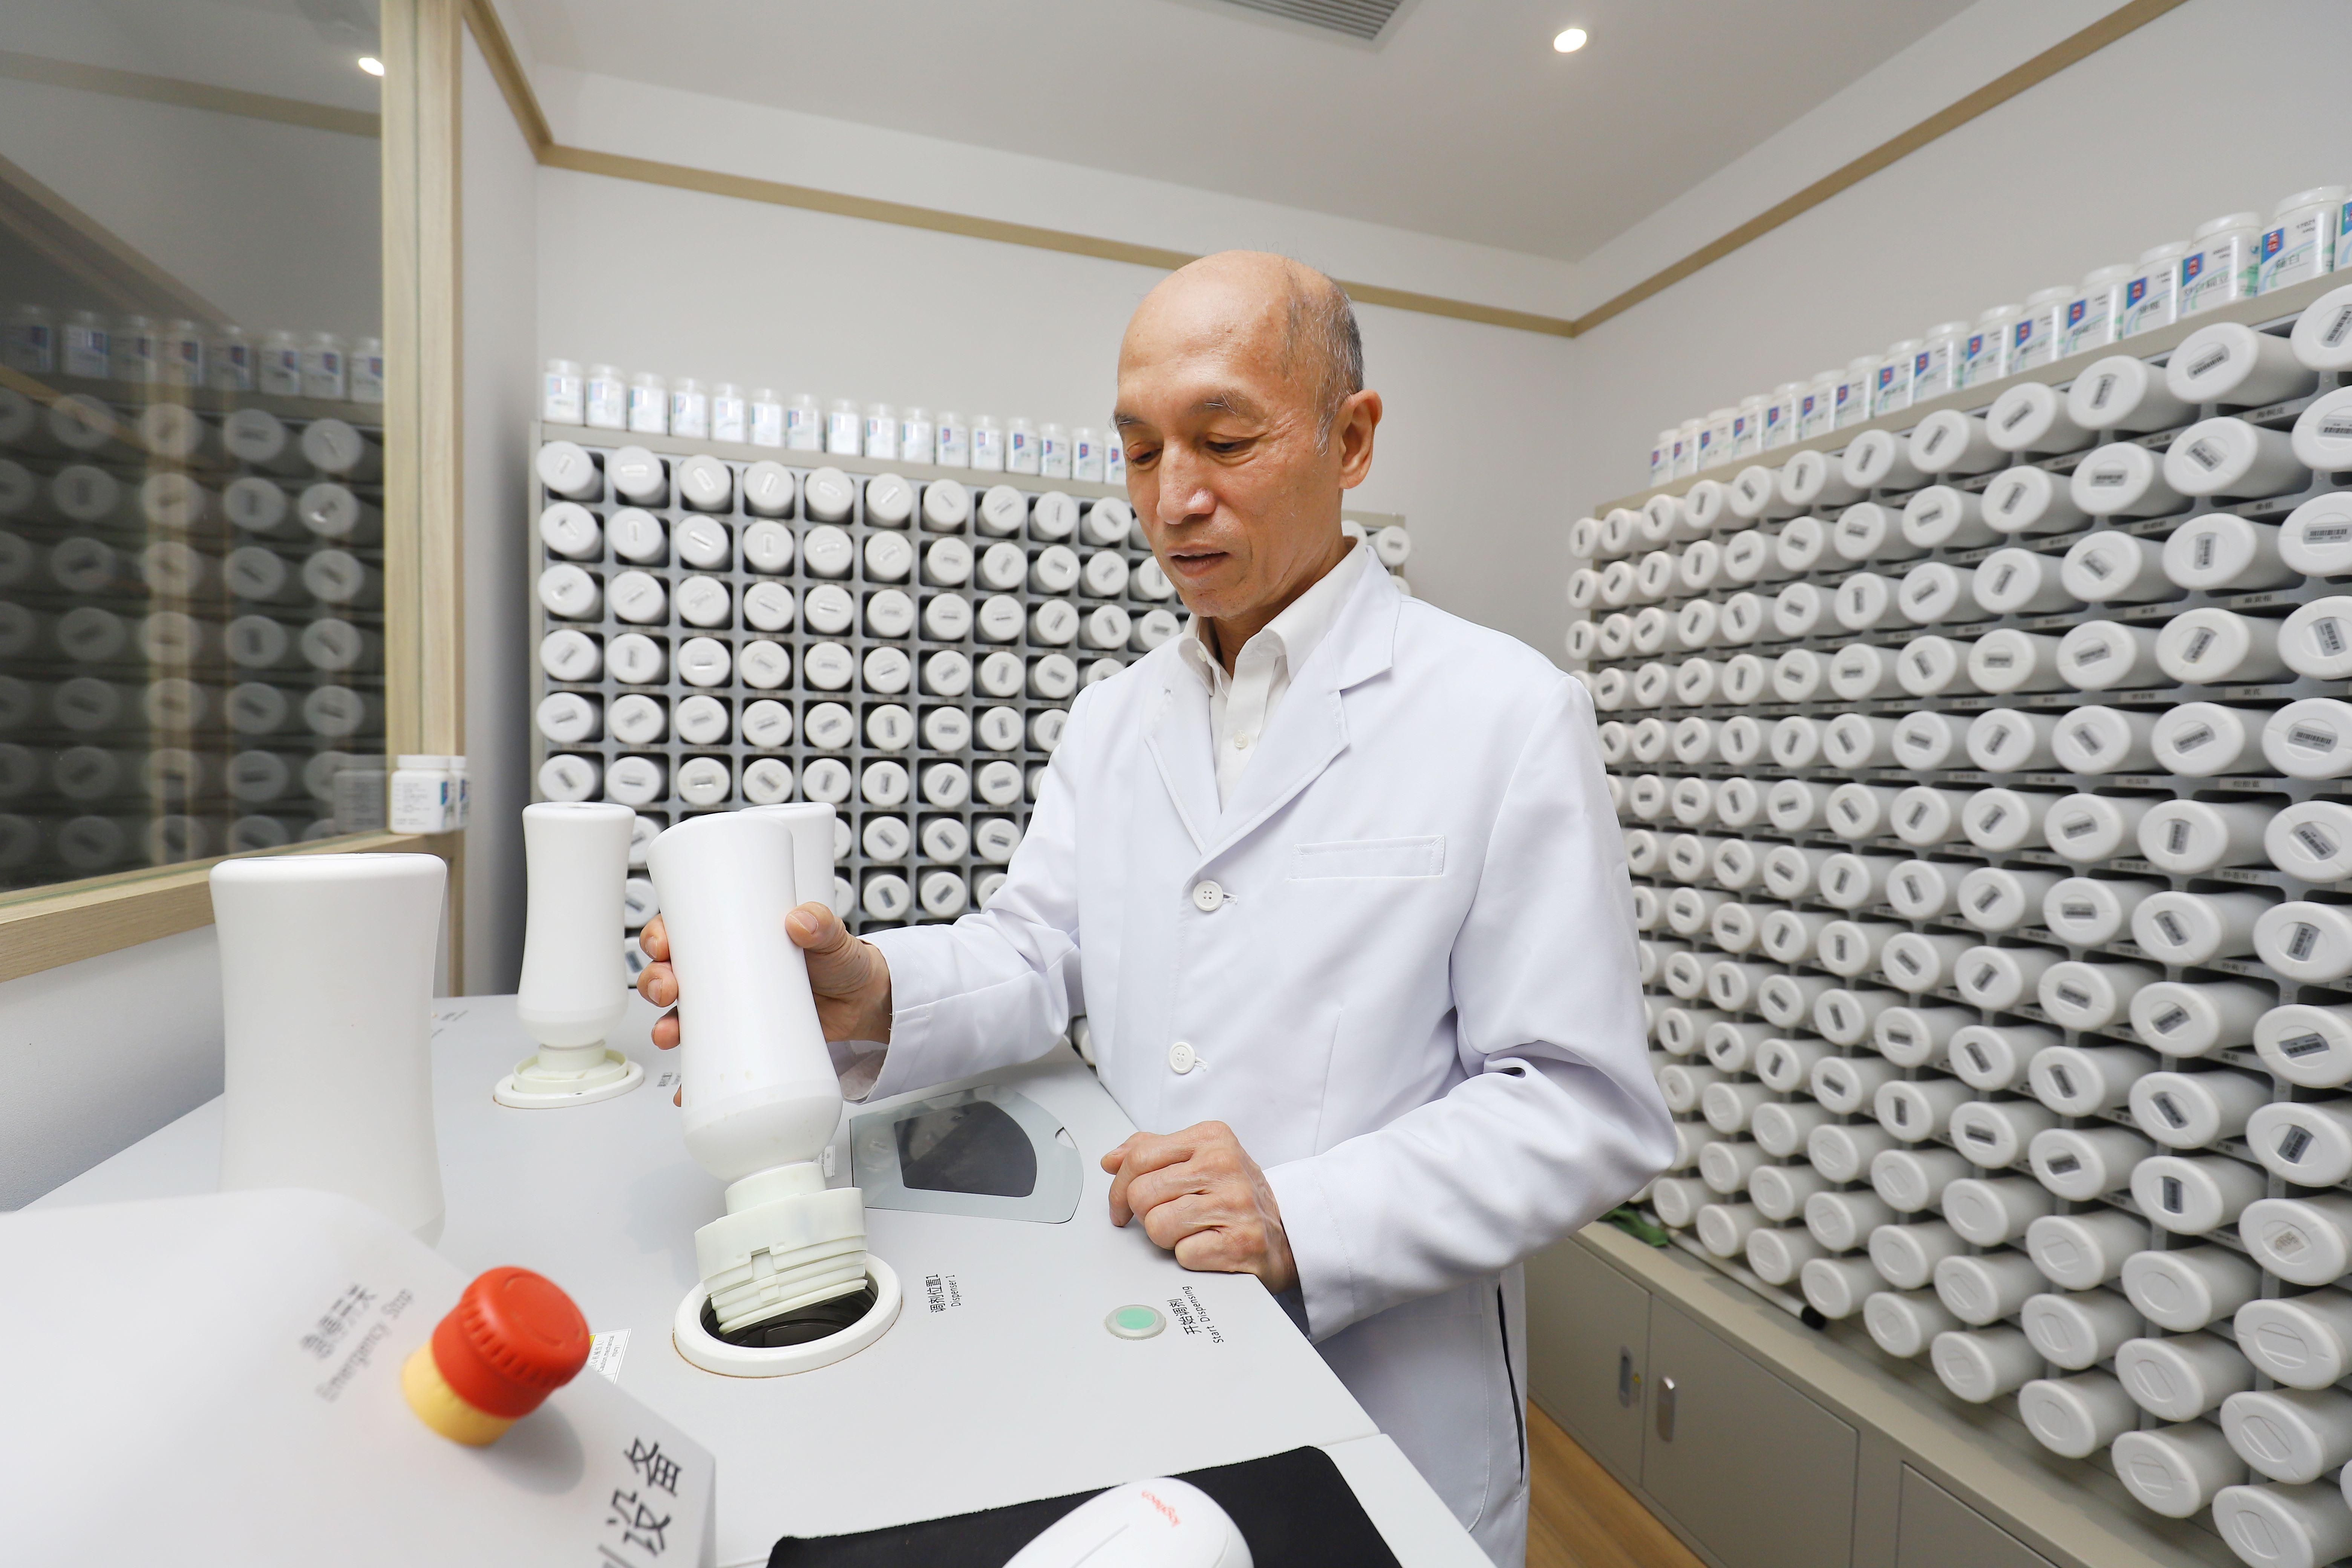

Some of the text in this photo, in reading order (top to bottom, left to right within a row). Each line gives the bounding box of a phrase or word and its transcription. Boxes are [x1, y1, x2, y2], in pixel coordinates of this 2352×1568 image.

[926, 1274, 946, 1312] 调剂位置1
[949, 1280, 962, 1306] Dispenser
[1167, 1298, 1202, 1335] 开始调剂
[1182, 1286, 1224, 1343] Start Dispensing
[598, 1436, 681, 1568] 设备
